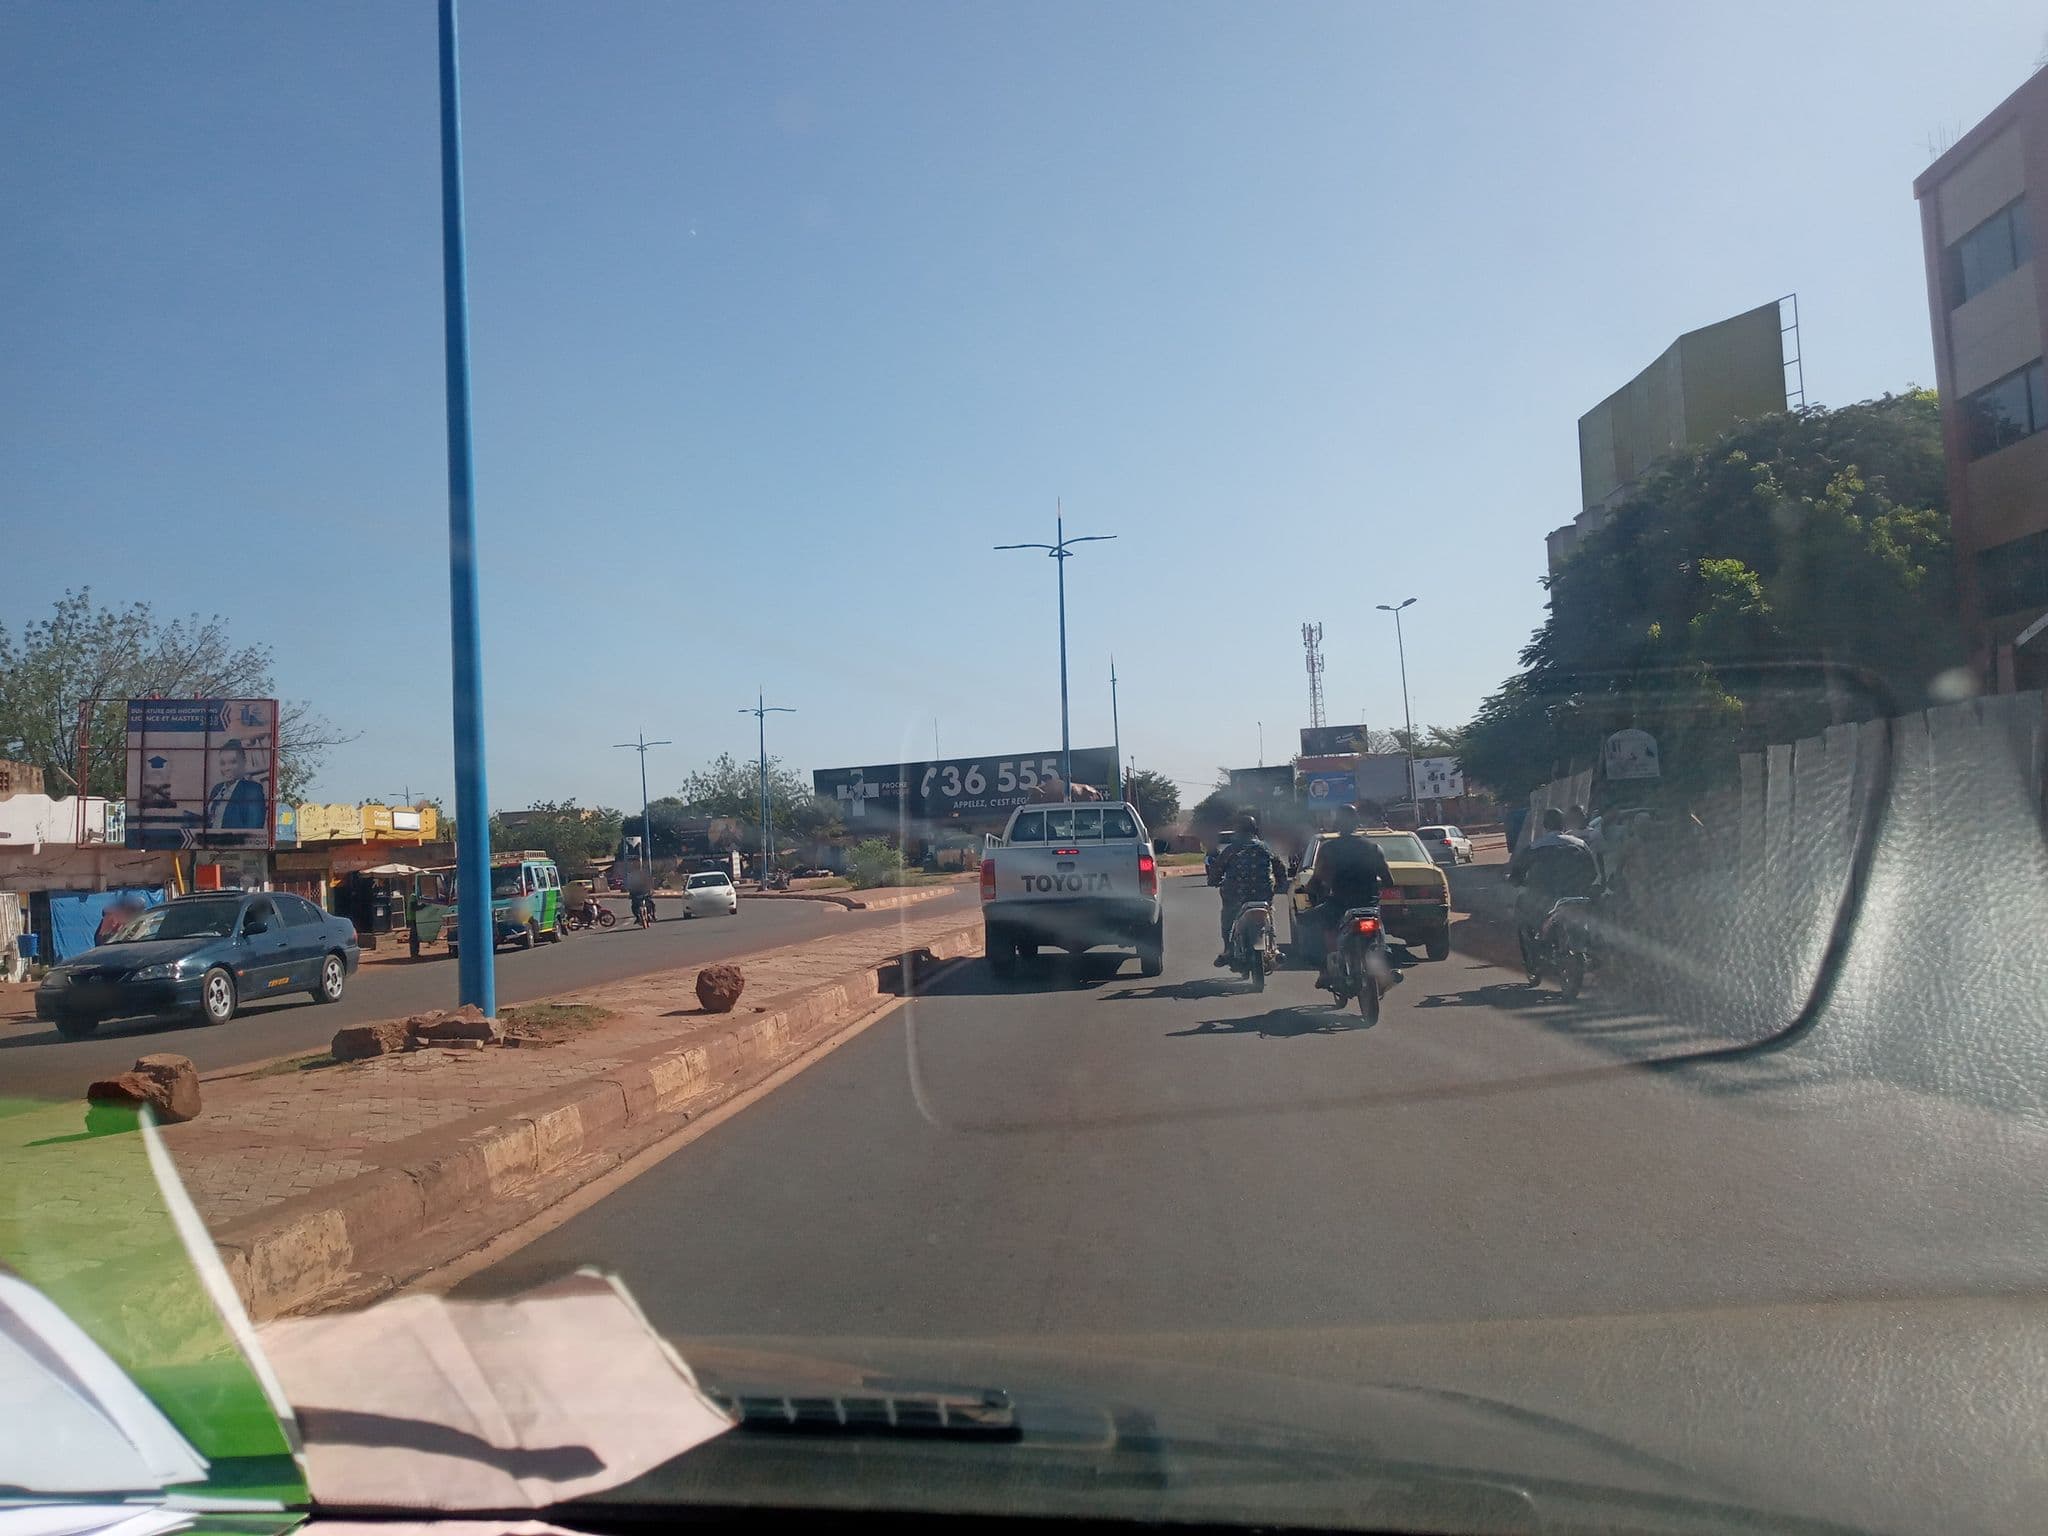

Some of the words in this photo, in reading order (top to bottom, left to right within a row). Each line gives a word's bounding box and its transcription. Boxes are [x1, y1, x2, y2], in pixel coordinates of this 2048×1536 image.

[941, 764, 987, 797] 36
[997, 759, 1060, 793] 555
[1021, 872, 1113, 893] TOYOTA
